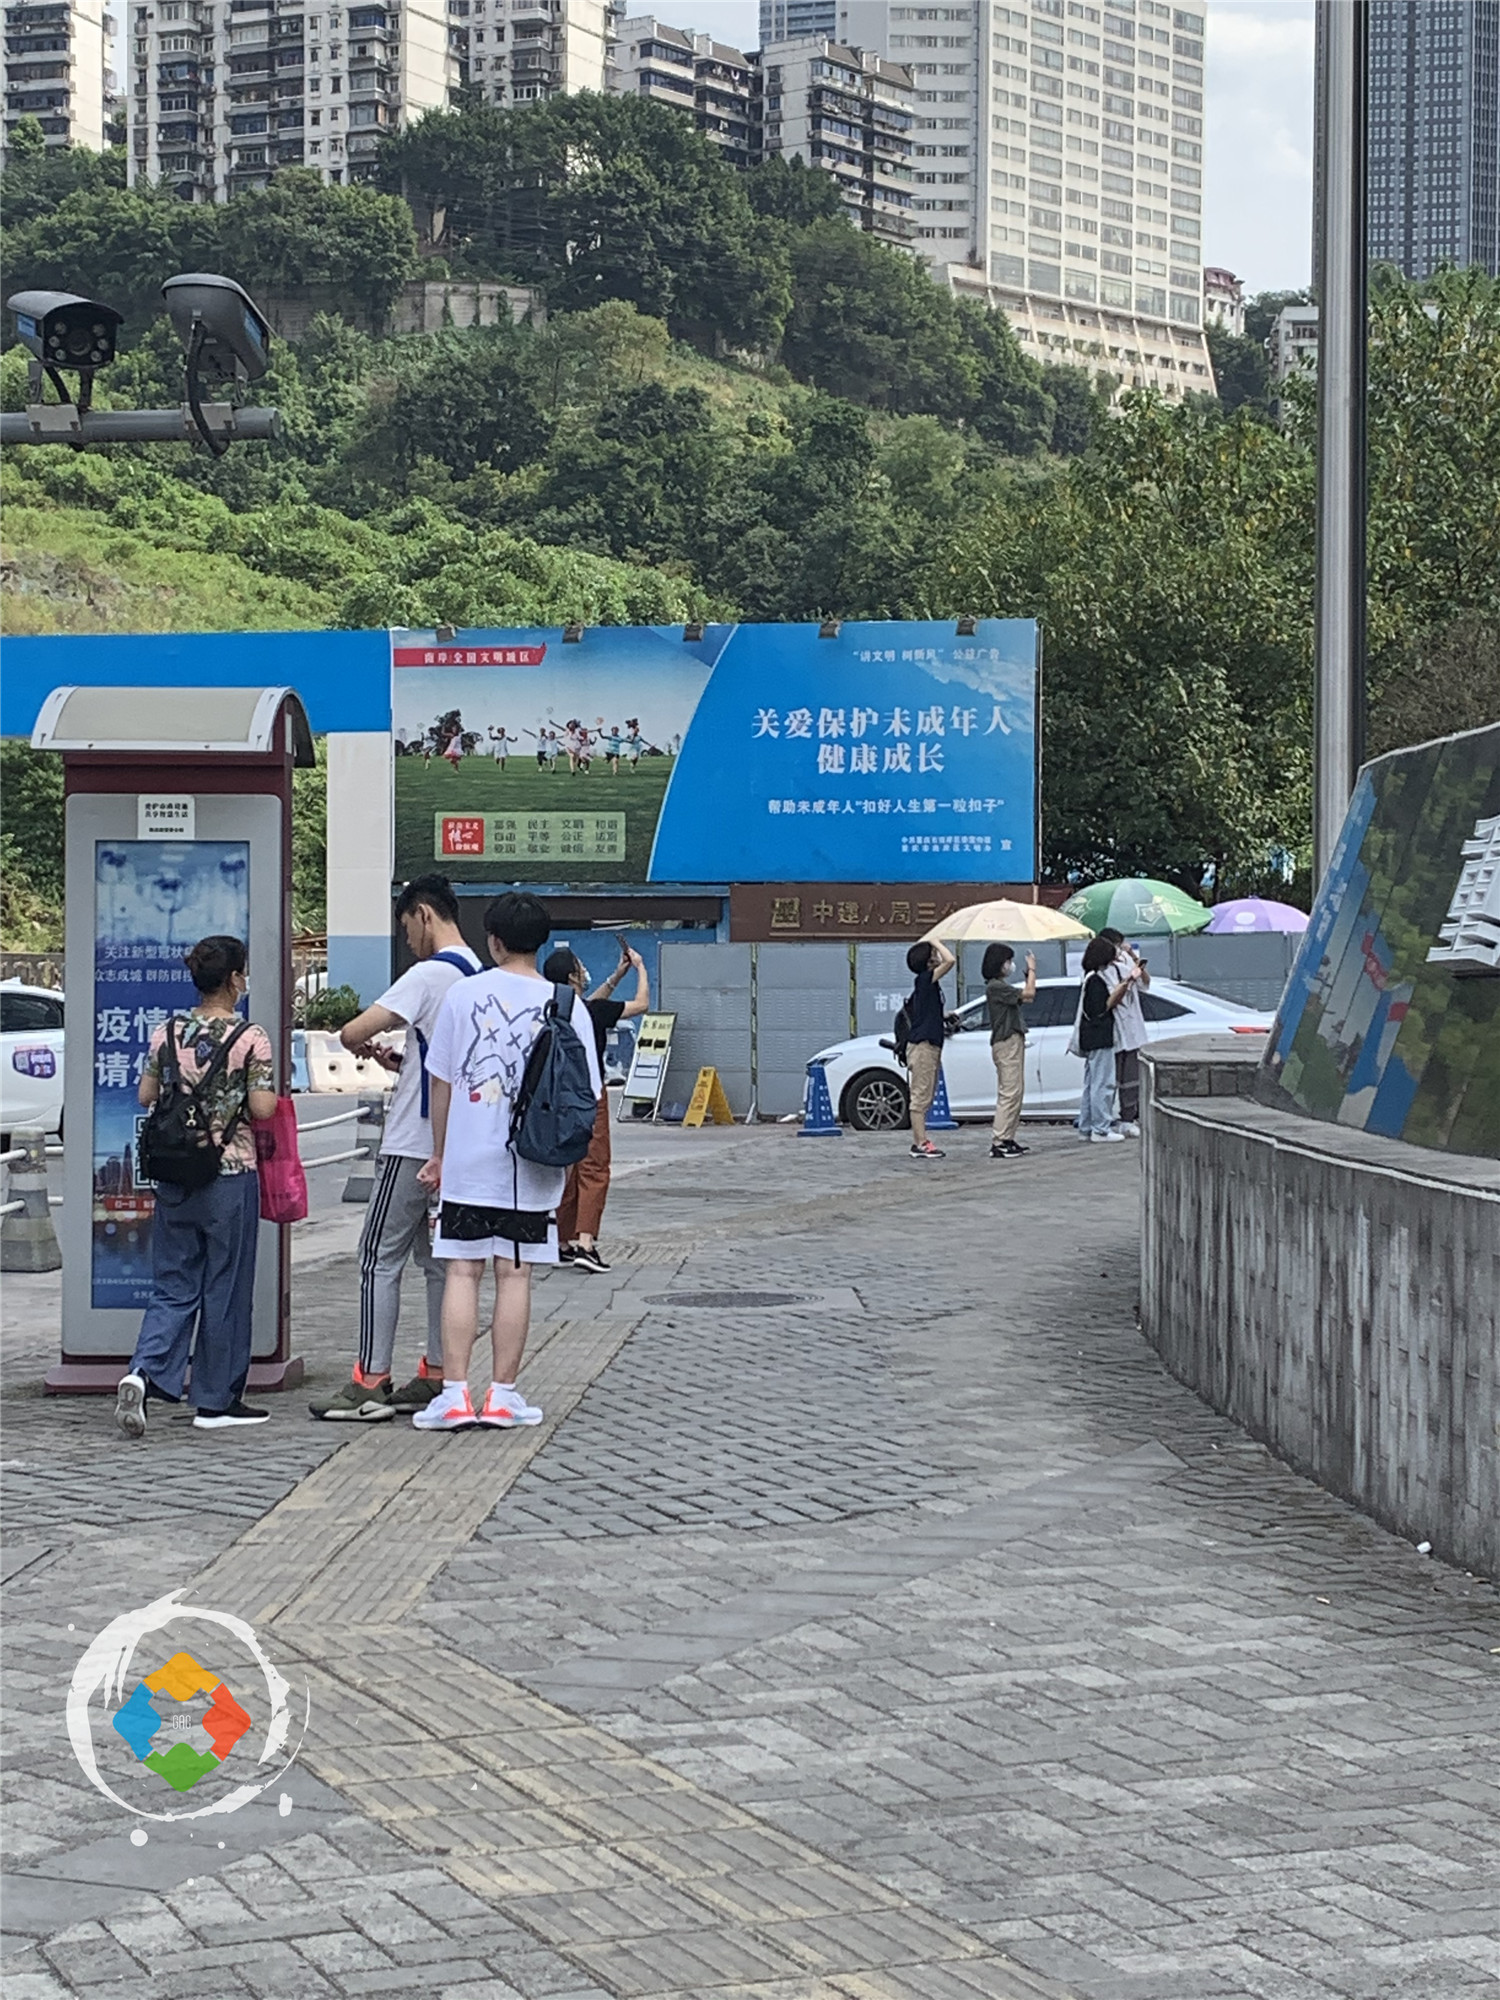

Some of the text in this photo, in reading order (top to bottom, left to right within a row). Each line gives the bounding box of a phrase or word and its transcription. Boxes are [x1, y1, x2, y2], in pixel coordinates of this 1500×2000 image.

[751, 704, 1012, 739] 关爱保护未成年人
[816, 742, 945, 775] 健康成长
